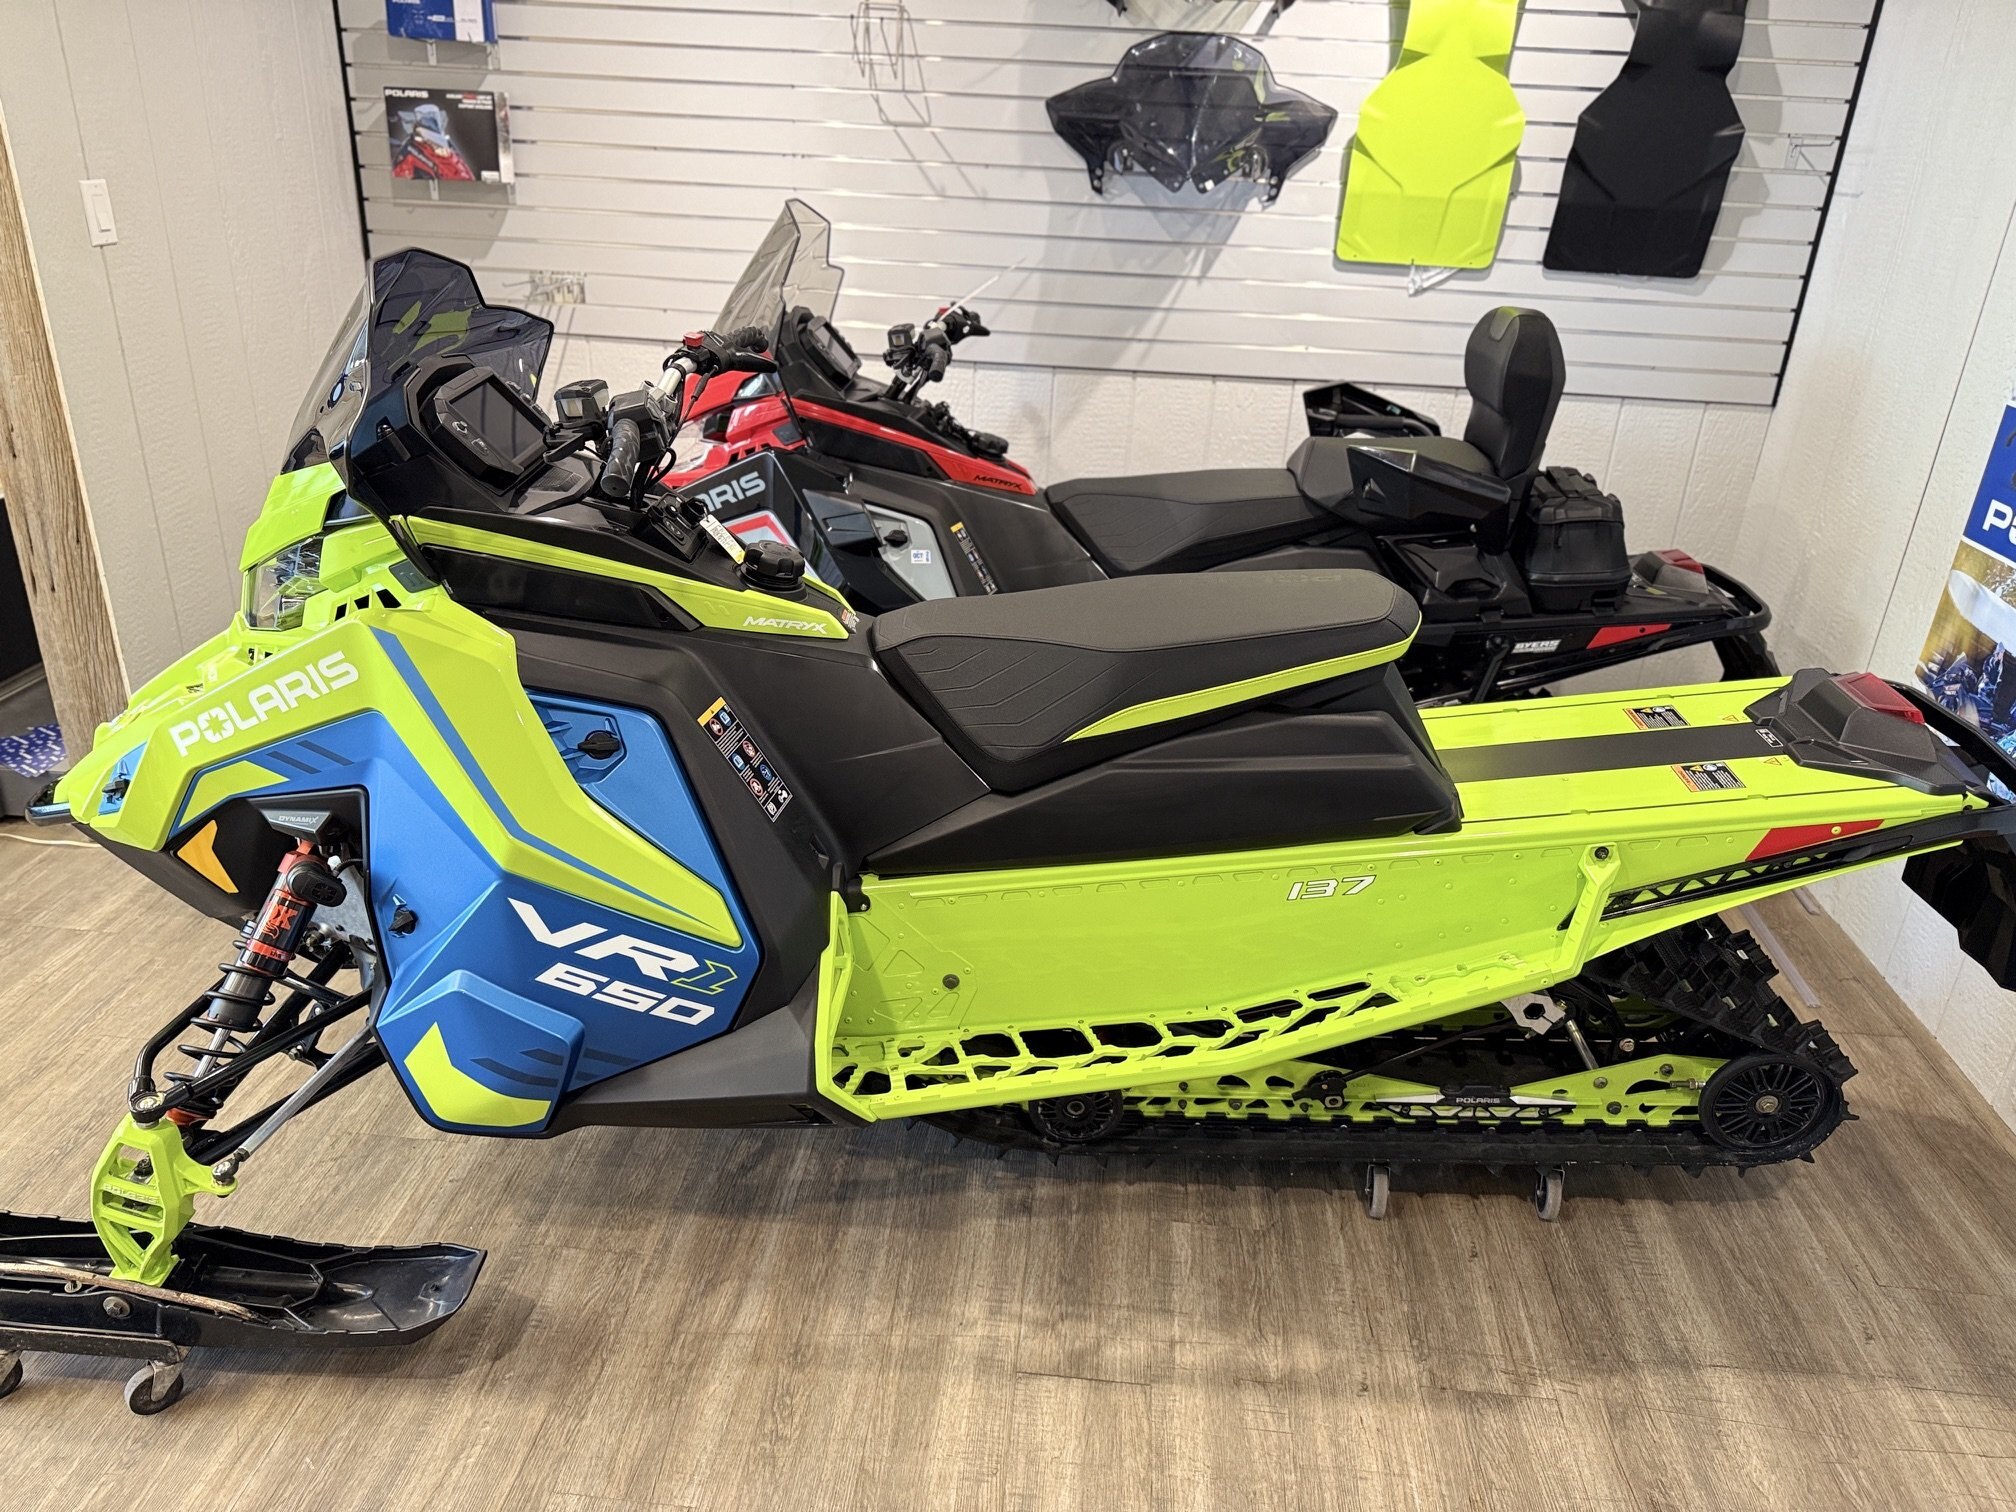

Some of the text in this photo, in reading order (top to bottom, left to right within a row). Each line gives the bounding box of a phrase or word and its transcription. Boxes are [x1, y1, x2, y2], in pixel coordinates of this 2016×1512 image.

[385, 89, 429, 98] POLARIS
[743, 616, 828, 634] MATRYX
[168, 650, 359, 757] POLARIS
[278, 815, 319, 824] DYNAMIX
[1286, 875, 1377, 901] 137
[507, 897, 738, 995] VR1
[534, 962, 715, 1026] 650
